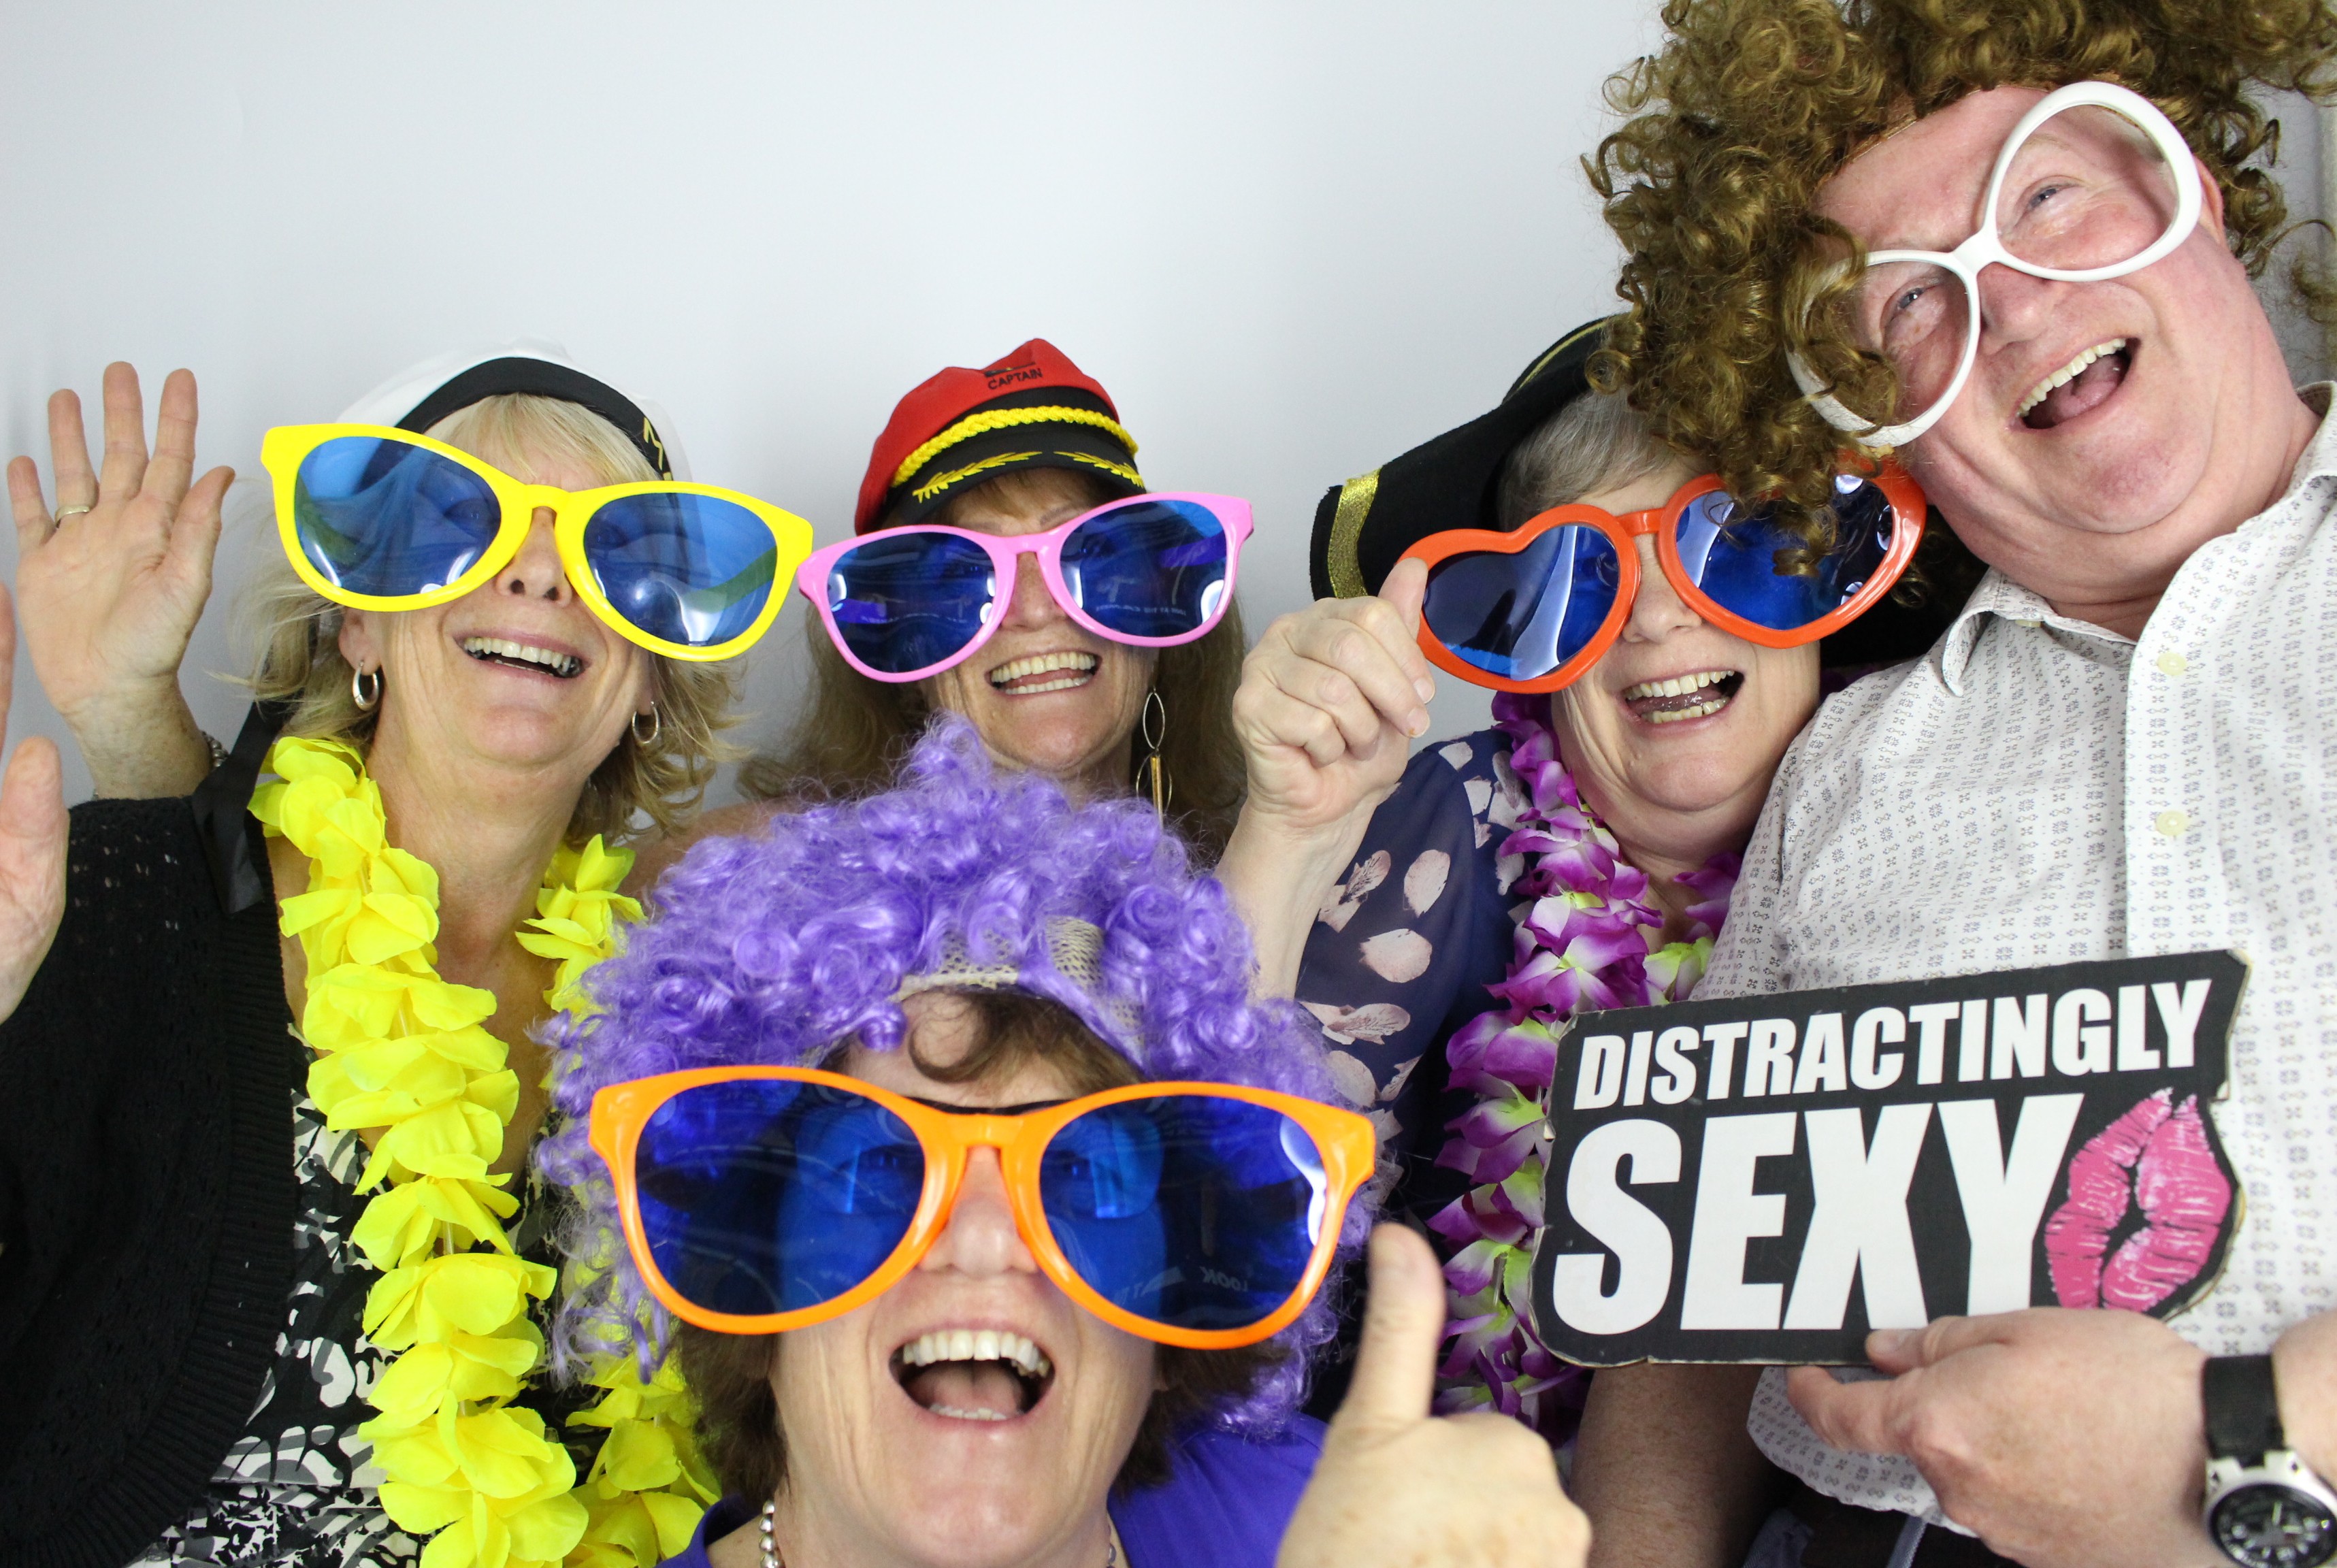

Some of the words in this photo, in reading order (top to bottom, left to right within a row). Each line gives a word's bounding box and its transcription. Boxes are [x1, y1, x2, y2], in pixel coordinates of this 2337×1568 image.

[988, 368, 1043, 389] CAPTAIN
[1573, 979, 2212, 1111] DISTRACTINGLY
[1552, 1093, 2085, 1335] SEXY
